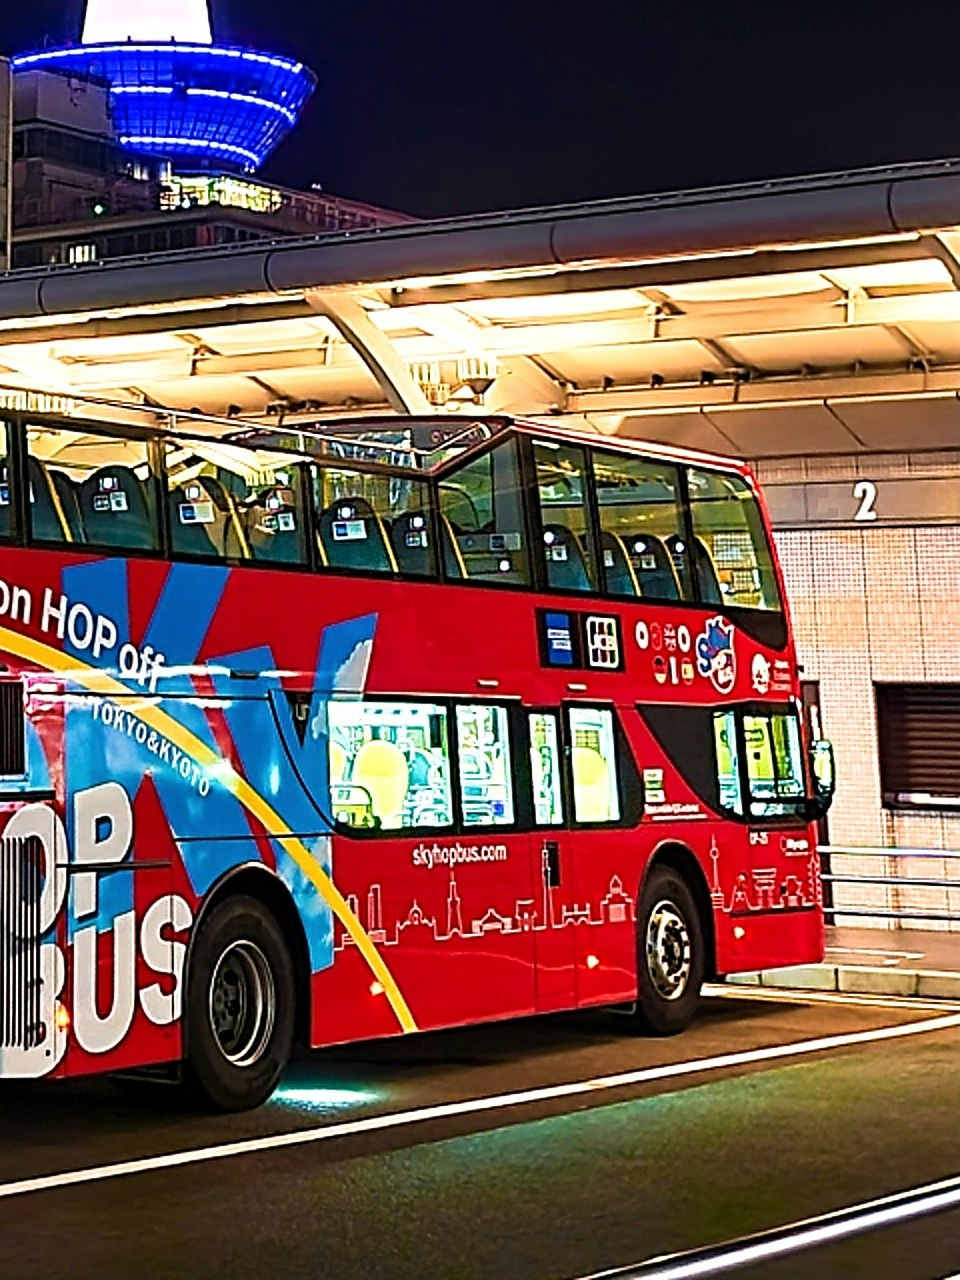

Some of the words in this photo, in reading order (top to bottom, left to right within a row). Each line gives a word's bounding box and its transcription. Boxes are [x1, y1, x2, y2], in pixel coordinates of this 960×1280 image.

[853, 481, 877, 521] 2
[41, 587, 117, 658] HOP
[119, 645, 166, 692] off
[90, 699, 211, 798] TOKYO&KYOTO
[412, 842, 508, 869] skyhopbus.com
